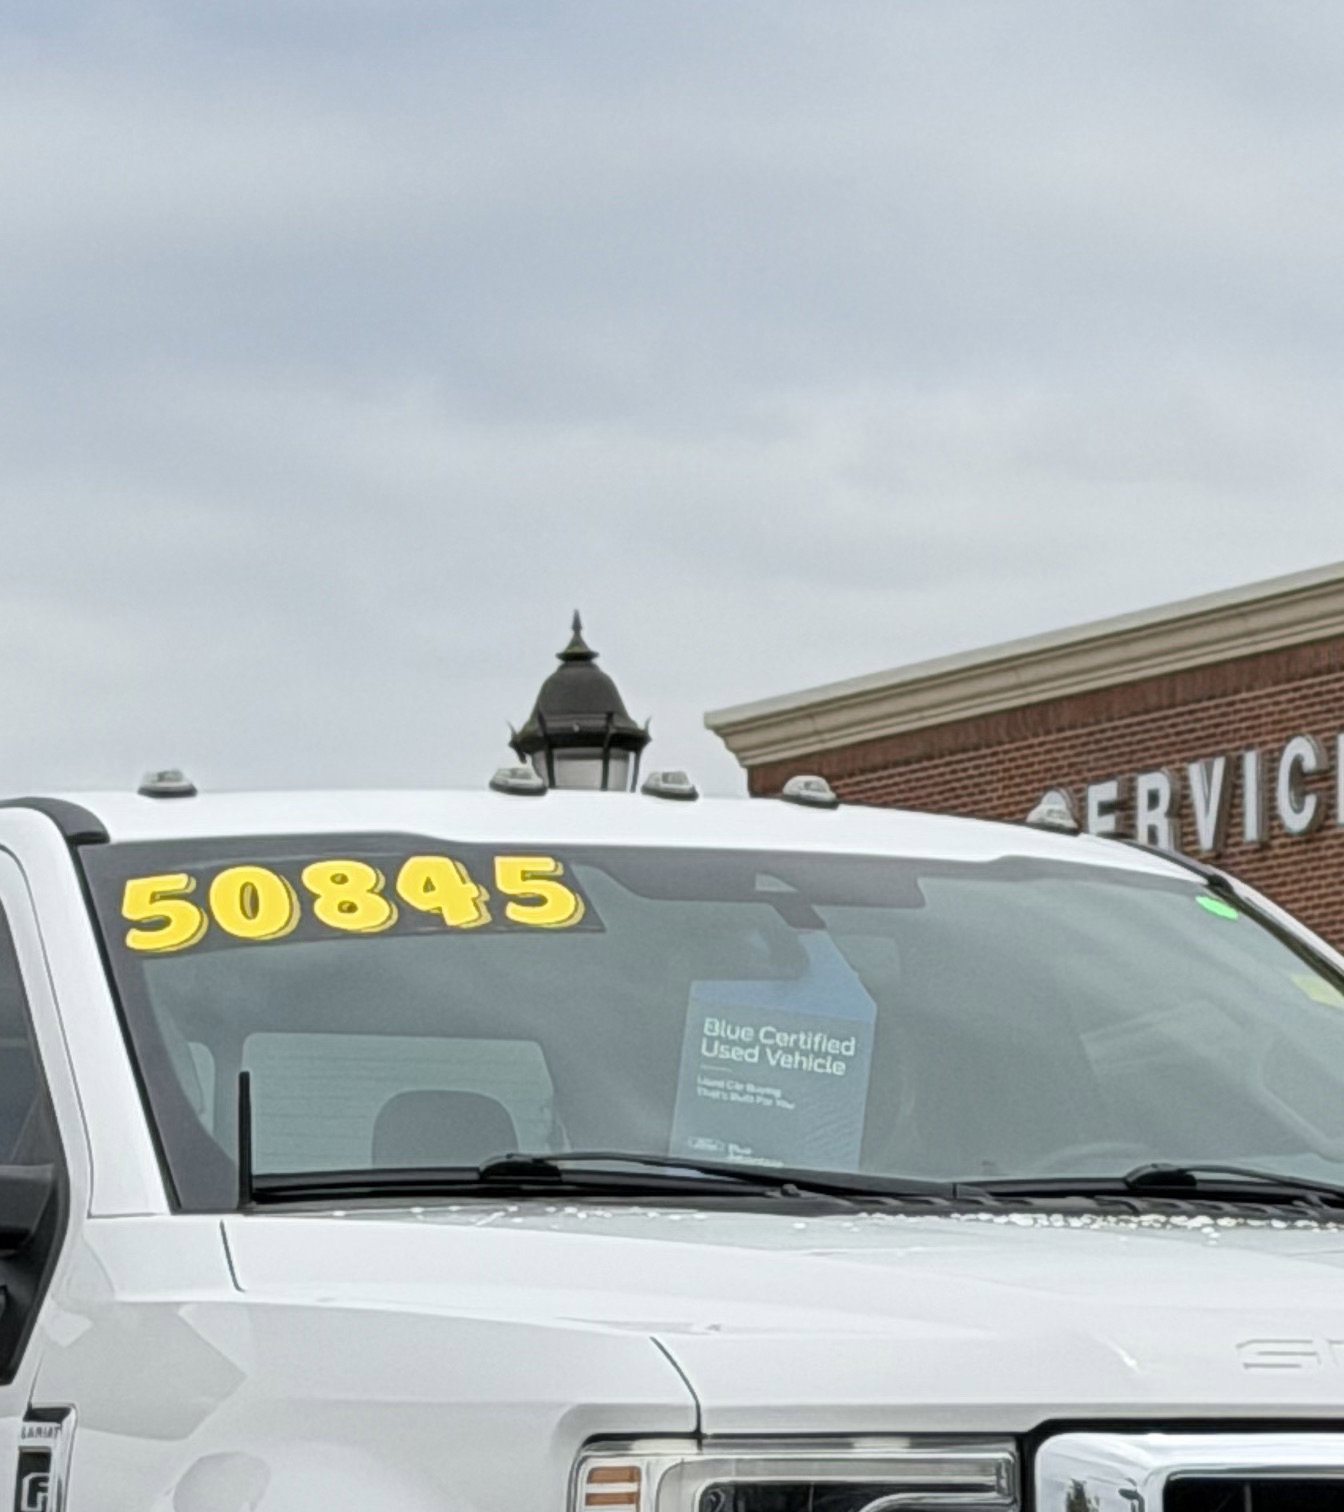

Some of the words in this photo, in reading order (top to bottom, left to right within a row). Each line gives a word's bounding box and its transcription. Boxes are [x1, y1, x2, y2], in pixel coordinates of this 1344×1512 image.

[120, 856, 585, 952] 50845
[700, 1037, 760, 1064] Used
[765, 1047, 847, 1076] Vehicle
[703, 1017, 755, 1042] Blue
[758, 1025, 856, 1057] Certified
